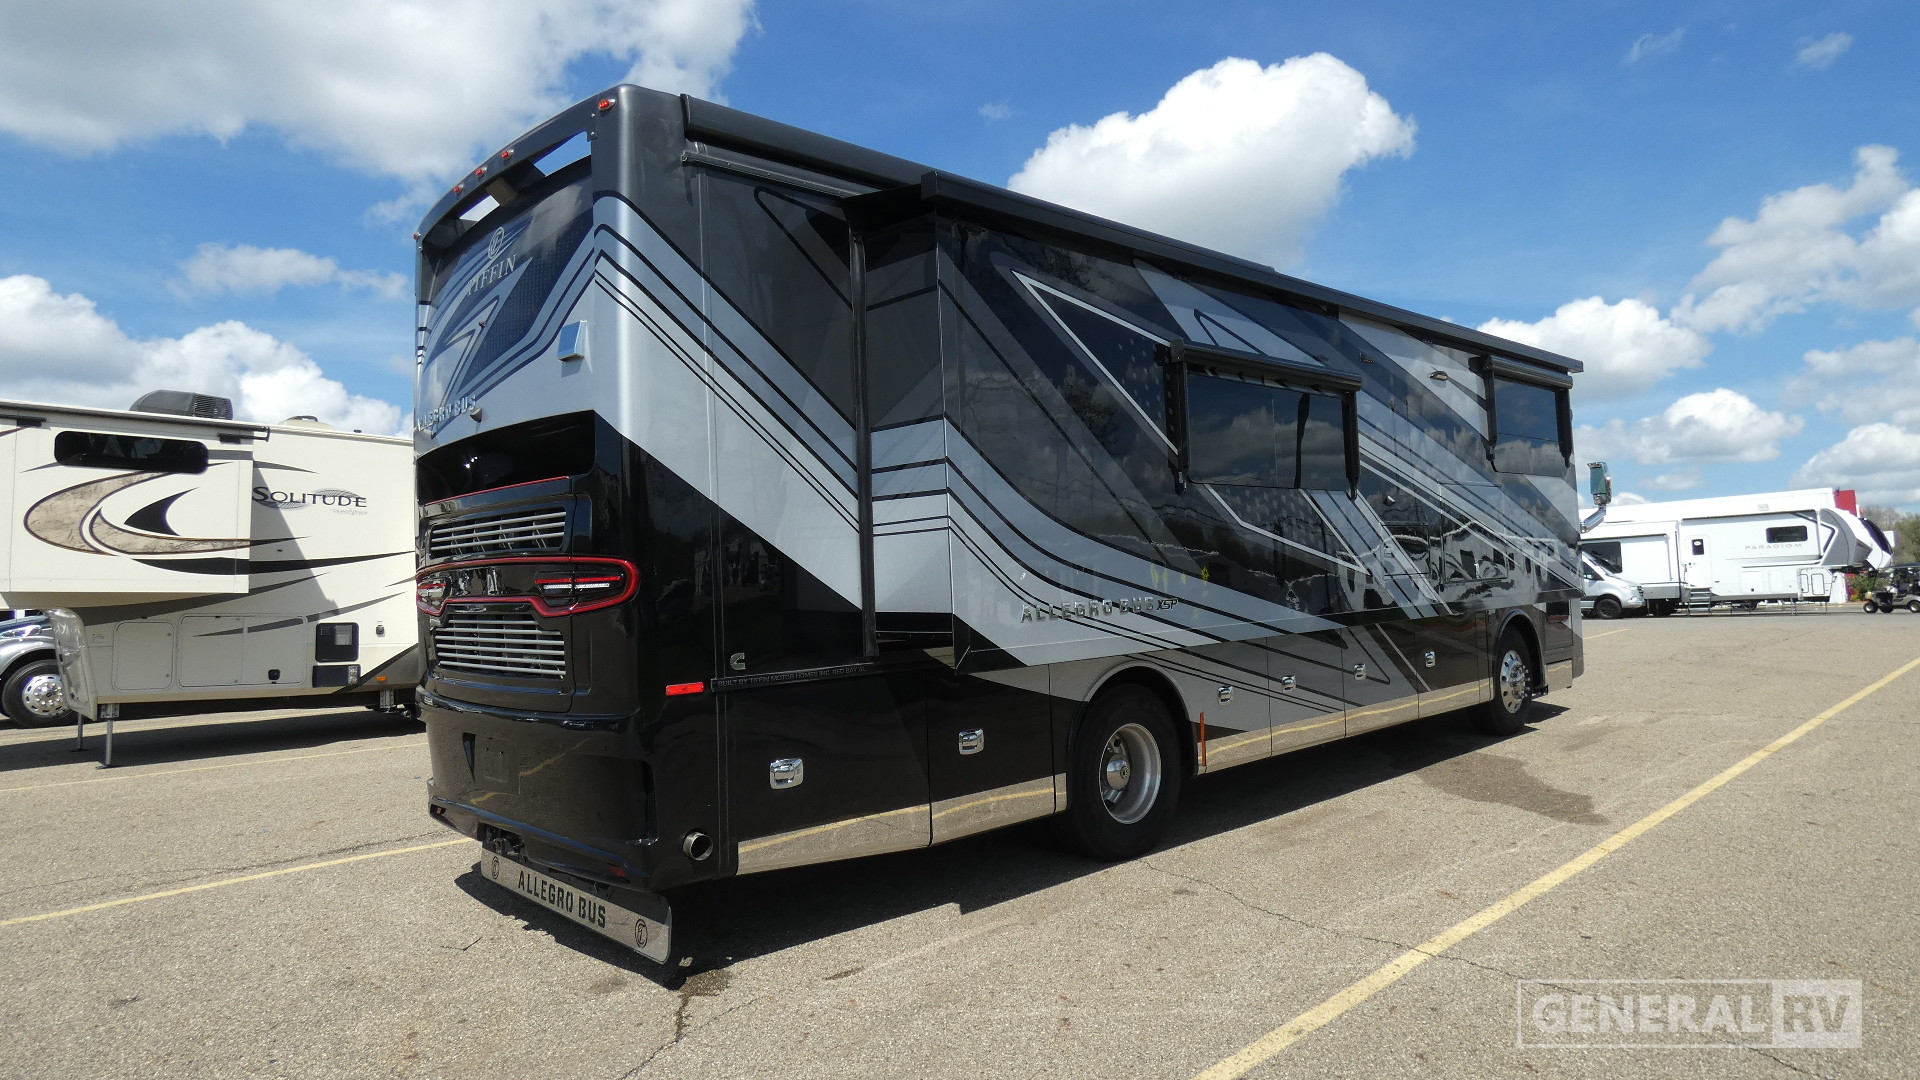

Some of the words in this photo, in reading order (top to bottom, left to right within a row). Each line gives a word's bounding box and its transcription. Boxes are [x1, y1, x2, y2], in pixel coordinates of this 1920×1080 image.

[251, 486, 367, 508] SOLITUDE
[1020, 599, 1114, 624] ALLEGRO
[1119, 596, 1154, 616] BUS
[1157, 598, 1179, 611] XSP
[717, 678, 738, 687] BUILT
[749, 675, 770, 684] TIFFIN
[770, 673, 795, 682] MOTOR
[795, 671, 818, 680] HOMES
[832, 668, 845, 676] RED
[518, 870, 574, 913] ALLEGRO
[578, 897, 607, 929] BUS
